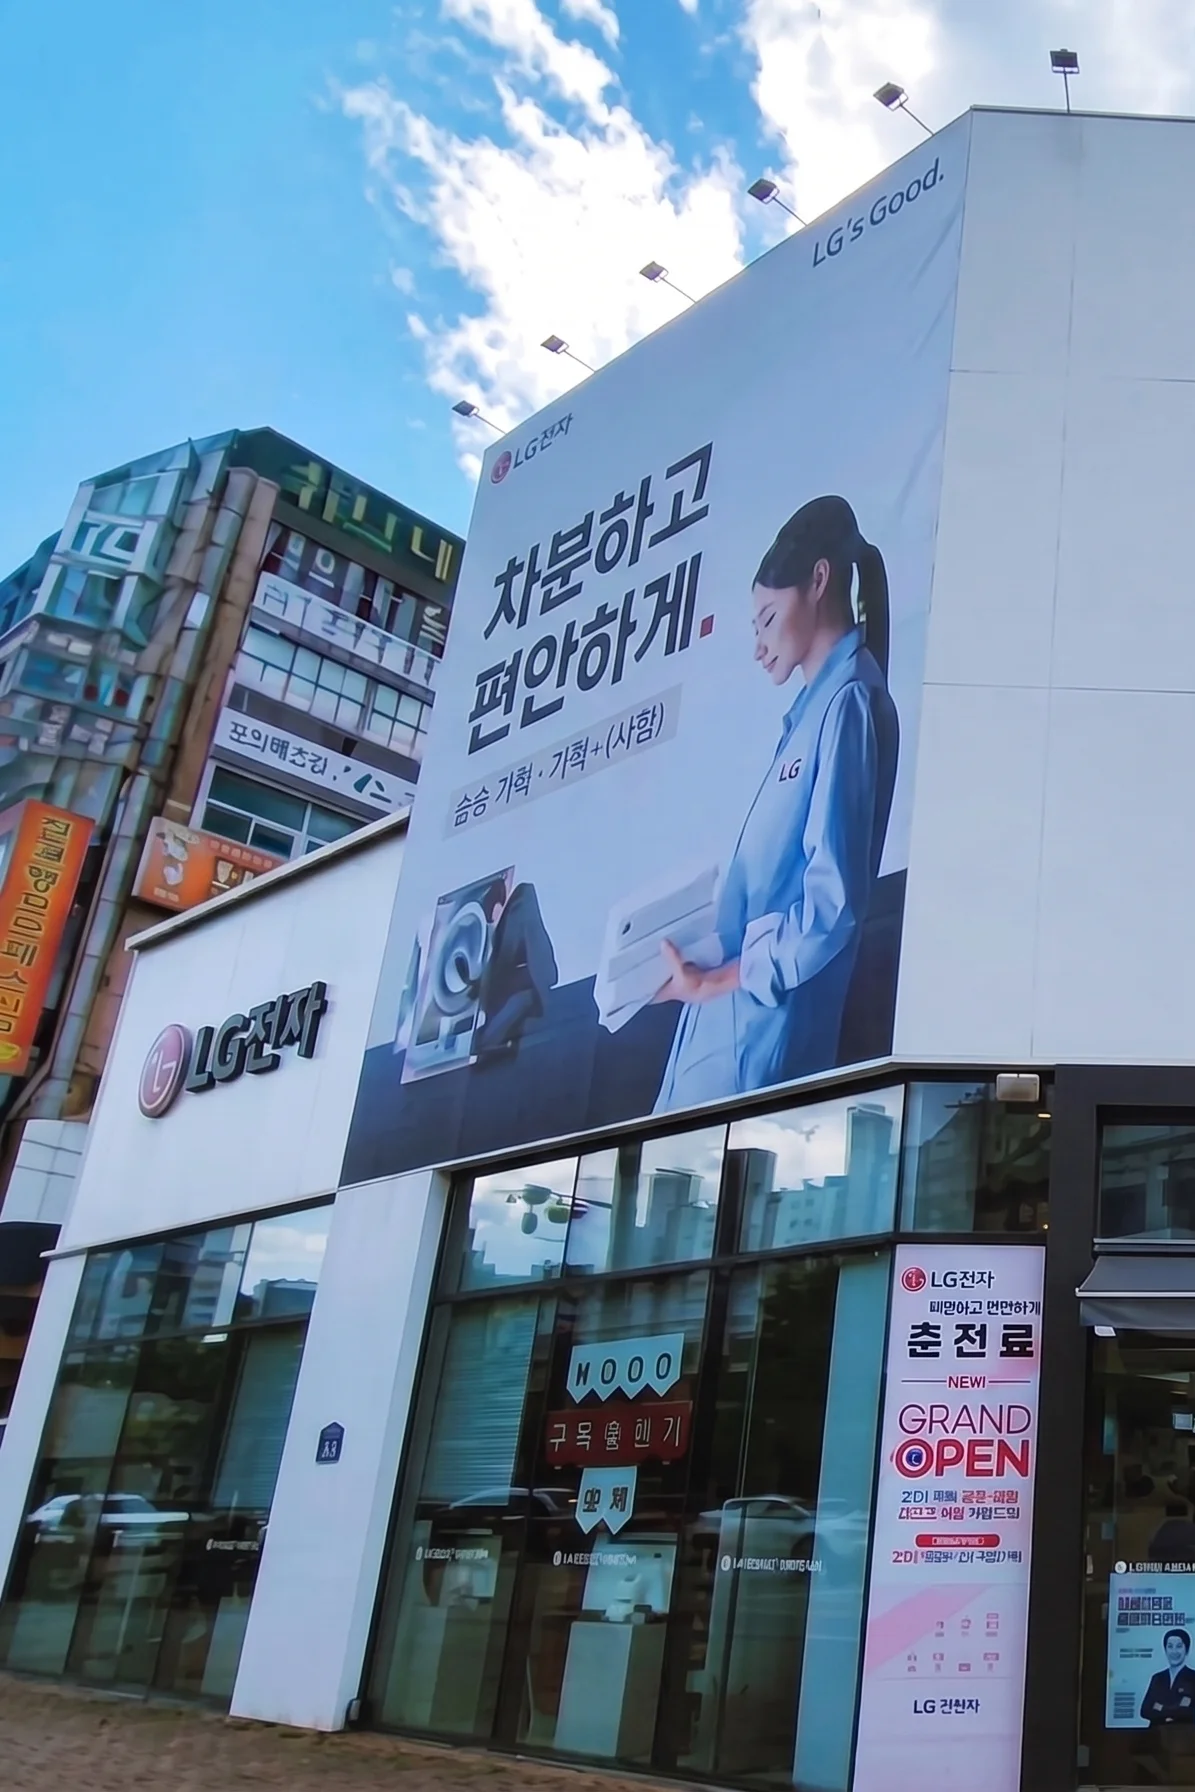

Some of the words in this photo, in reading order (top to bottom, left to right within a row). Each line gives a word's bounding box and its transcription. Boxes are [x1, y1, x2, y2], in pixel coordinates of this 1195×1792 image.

[812, 217, 864, 268] LG's
[869, 156, 944, 226] Good.
[483, 441, 714, 640] 차분하고
[467, 551, 715, 756] 편안하게.
[778, 758, 802, 782] LG
[185, 980, 329, 1094] LG전자
[931, 1270, 995, 1289] LG전자
[898, 1404, 1032, 1435] GRAND
[894, 1438, 1030, 1478] OPEN
[913, 1699, 936, 1714] LG
